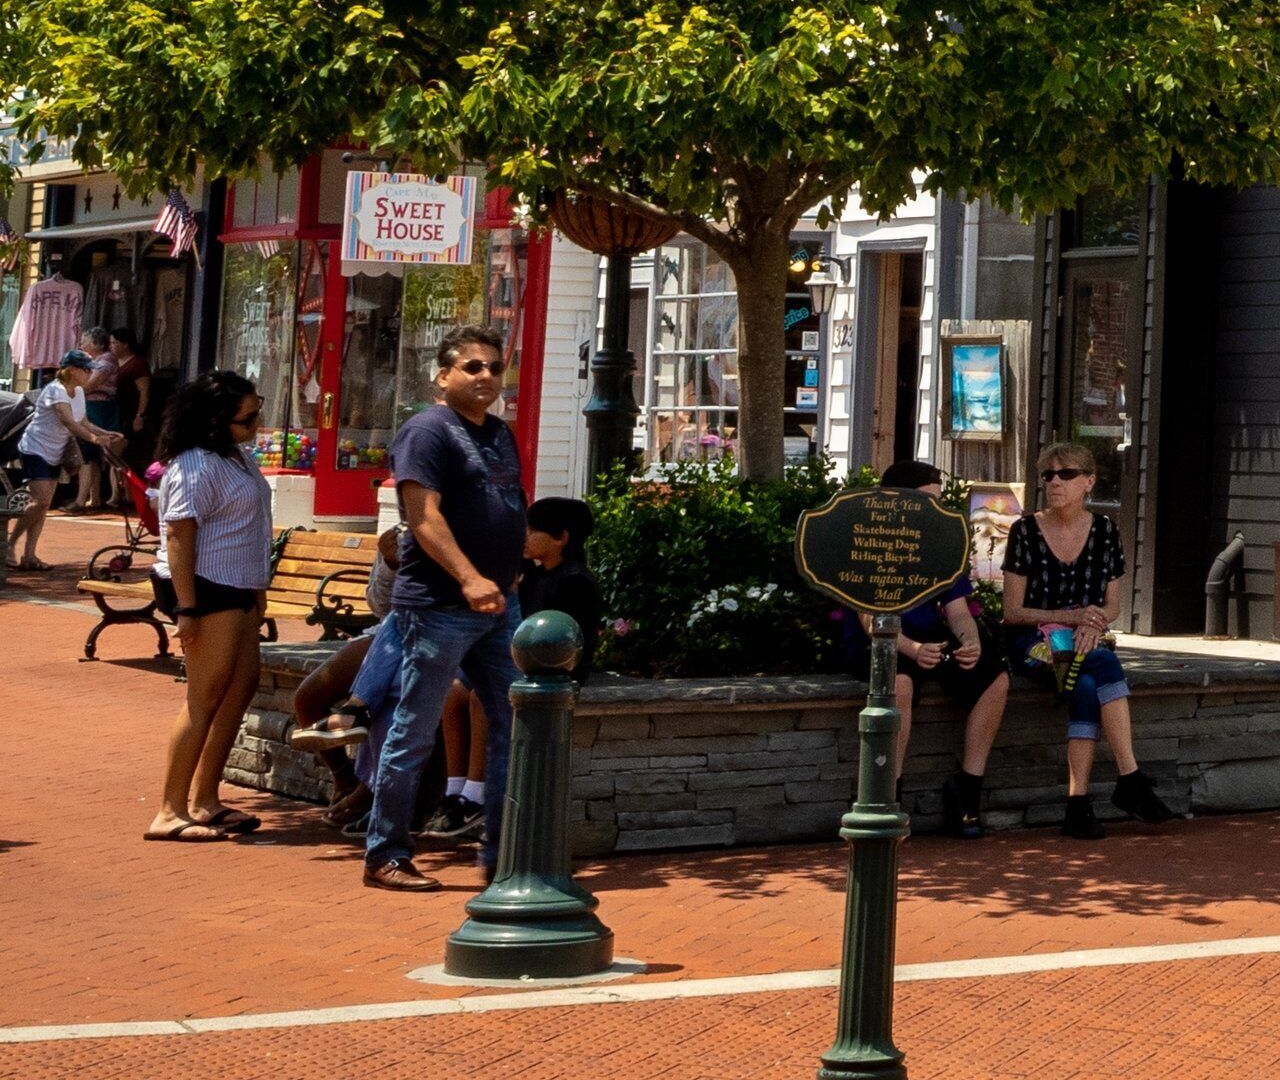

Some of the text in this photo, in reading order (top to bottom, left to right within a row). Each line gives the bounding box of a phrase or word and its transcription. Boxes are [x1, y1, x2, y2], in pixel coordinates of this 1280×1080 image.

[375, 197, 446, 220] SWEET
[376, 219, 445, 241] HOUSE
[863, 497, 922, 512] Thank You
[871, 512, 887, 522] For
[853, 524, 921, 540] Skateboarding
[854, 537, 920, 552] Walking Dogs
[838, 571, 939, 587] Wasington Stret
[874, 588, 904, 601] Mall
